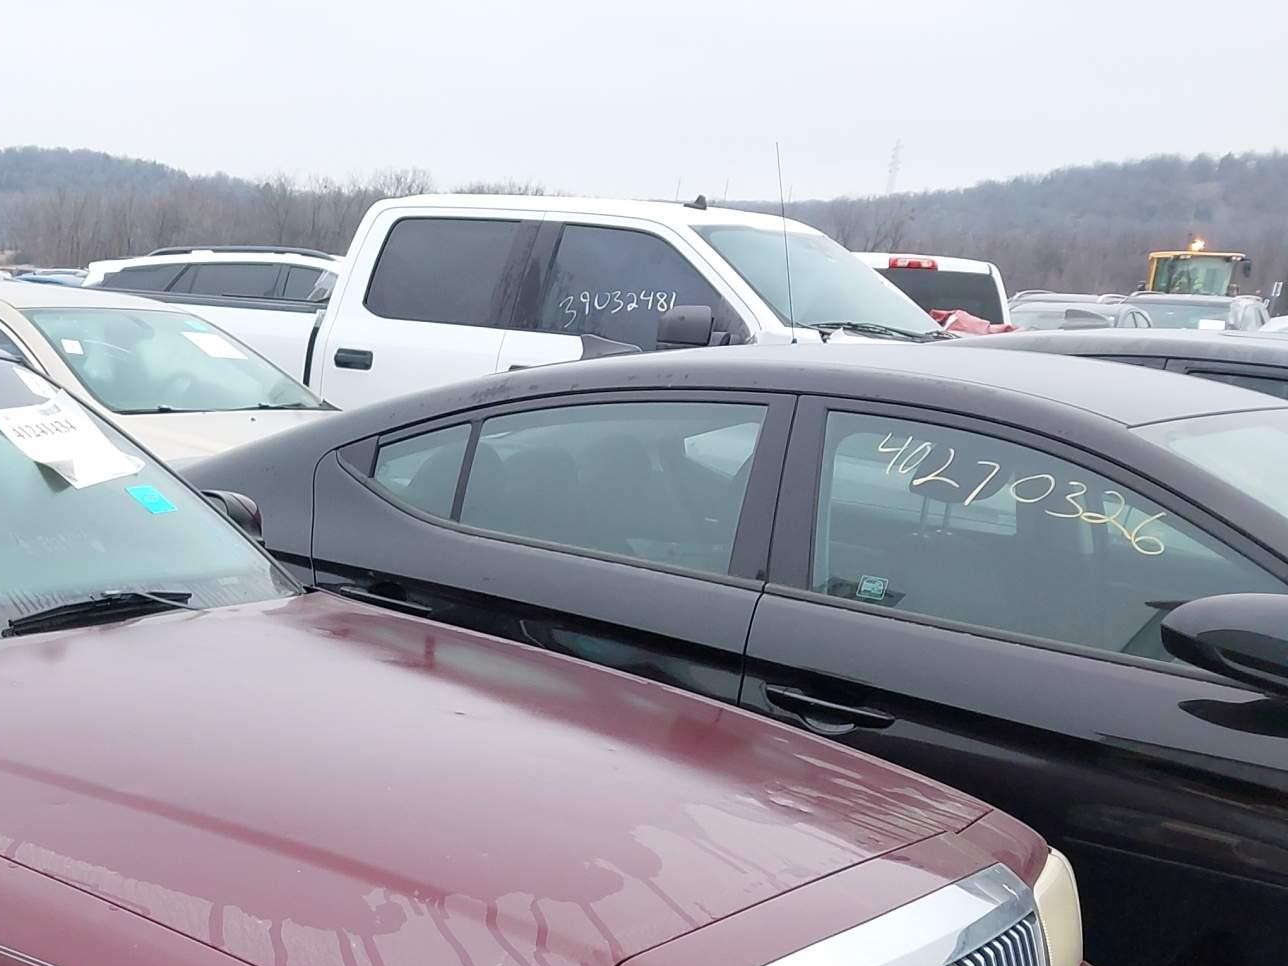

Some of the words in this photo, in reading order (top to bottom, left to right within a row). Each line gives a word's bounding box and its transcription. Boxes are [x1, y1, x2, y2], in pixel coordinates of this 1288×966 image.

[559, 289, 677, 328] 39032481
[12, 418, 79, 440] 41241434
[877, 432, 1167, 555] 40270326
